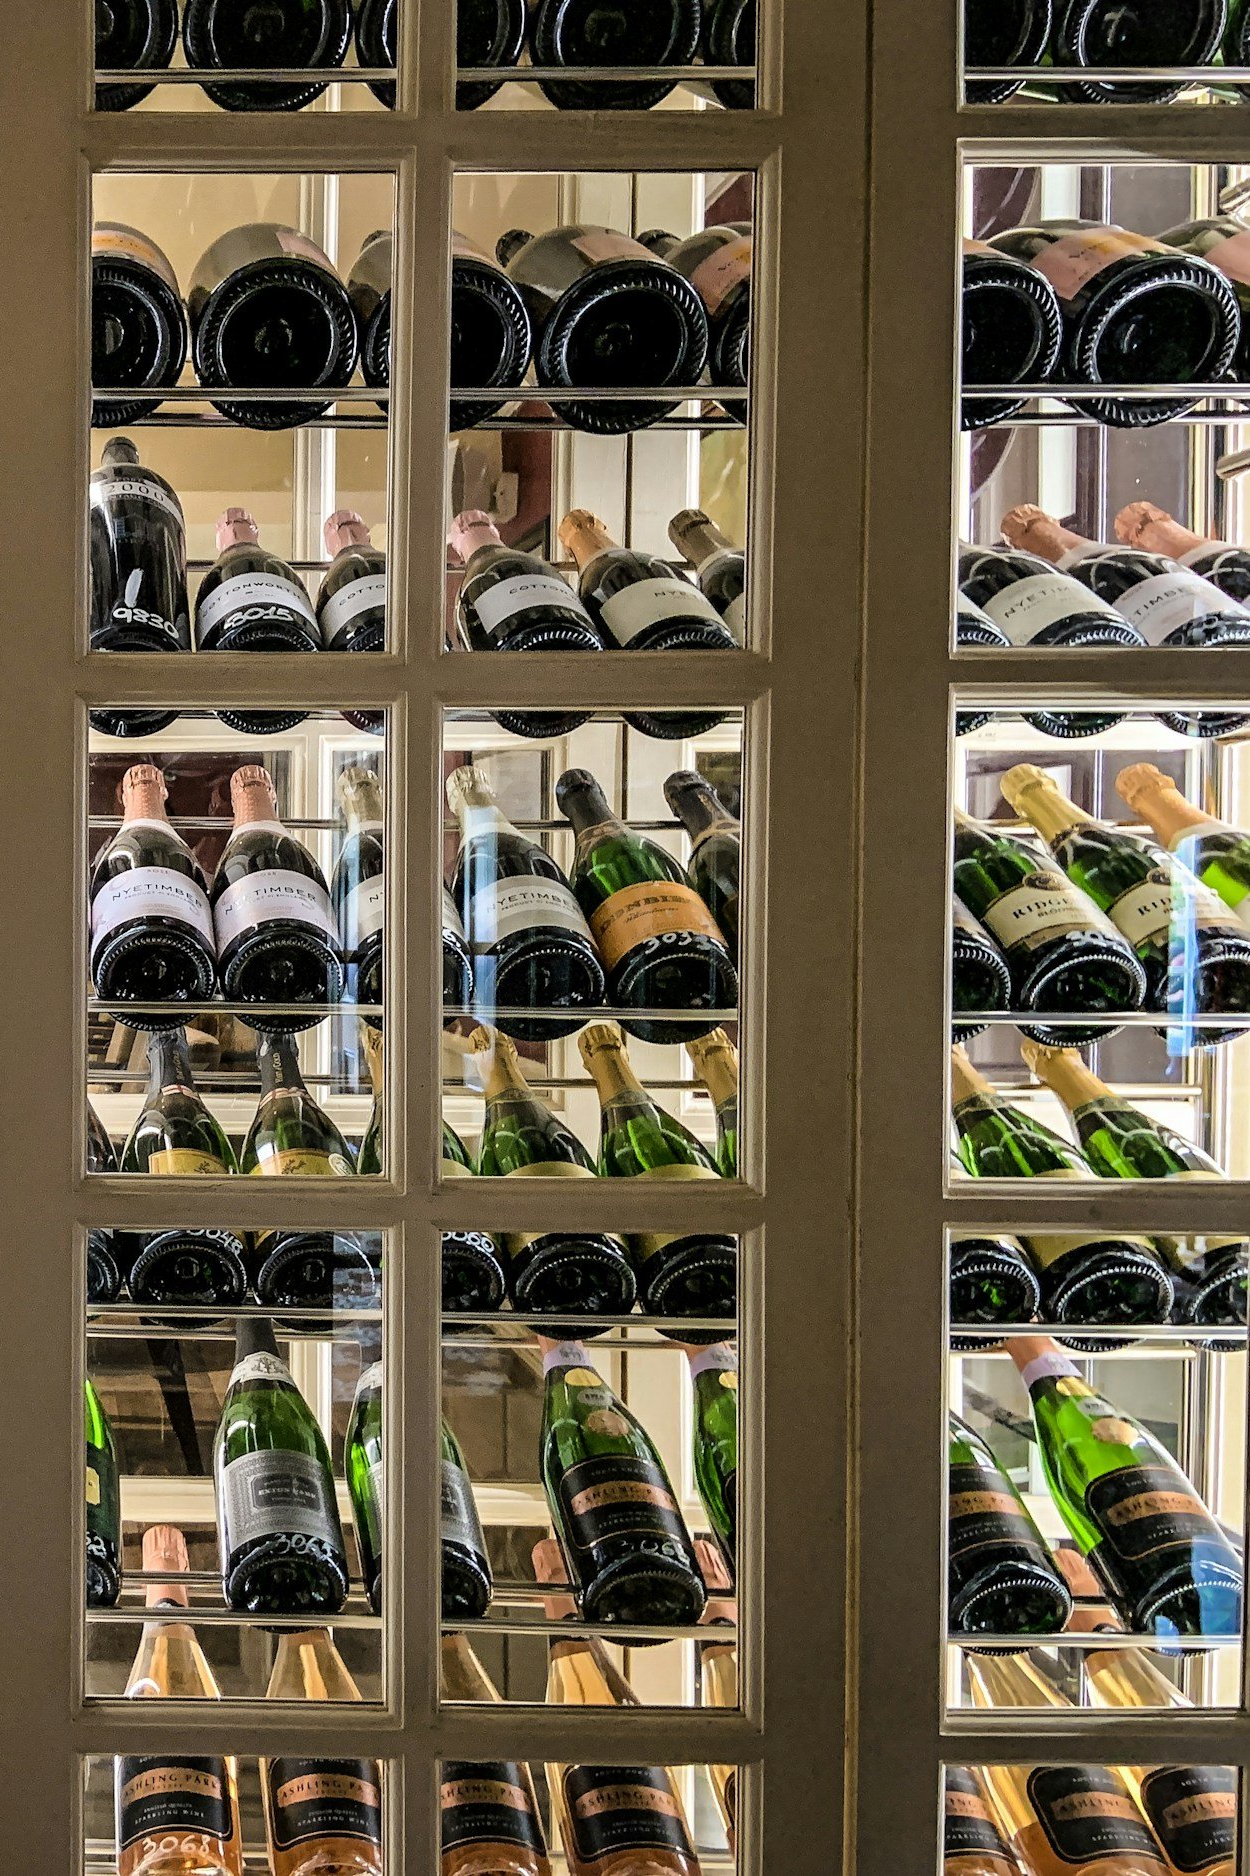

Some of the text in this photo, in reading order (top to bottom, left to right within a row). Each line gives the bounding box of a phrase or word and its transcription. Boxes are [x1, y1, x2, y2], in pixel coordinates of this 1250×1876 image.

[109, 483, 163, 501] 2000
[113, 606, 178, 639] 9830
[112, 883, 203, 908] NYETIMBER
[225, 886, 317, 916] NTIMBER
[124, 1772, 217, 1798] ASHLING PARK
[281, 1779, 343, 1800] ASHLING
